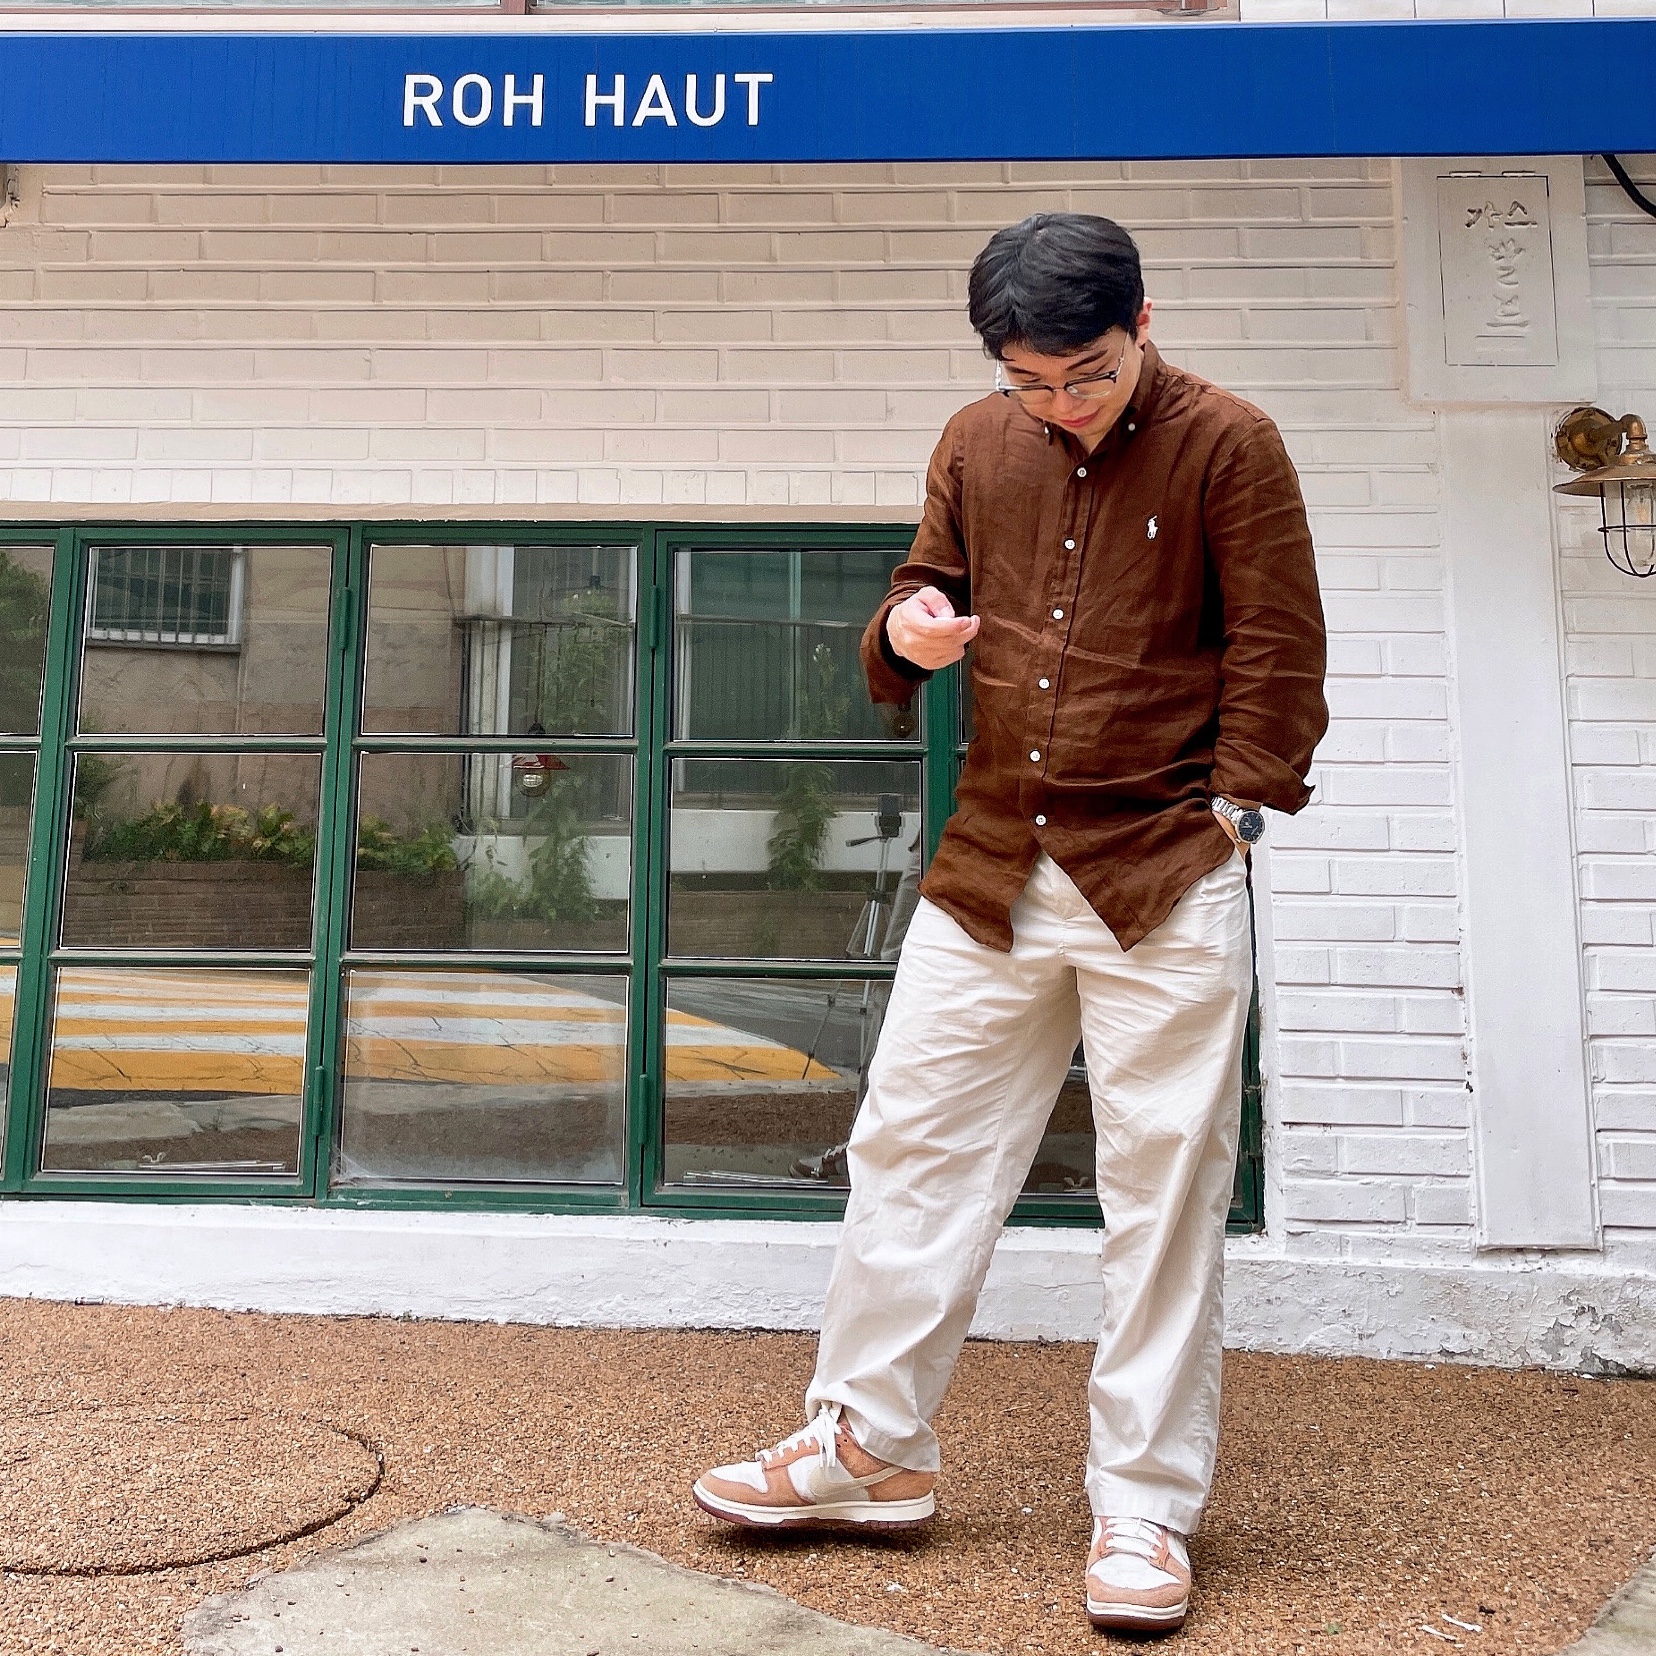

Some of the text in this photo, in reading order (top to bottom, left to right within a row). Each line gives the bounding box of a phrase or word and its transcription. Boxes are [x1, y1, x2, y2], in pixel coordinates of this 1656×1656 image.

[403, 73, 774, 127] ROH HAUT
[1465, 201, 1538, 229] 가스
